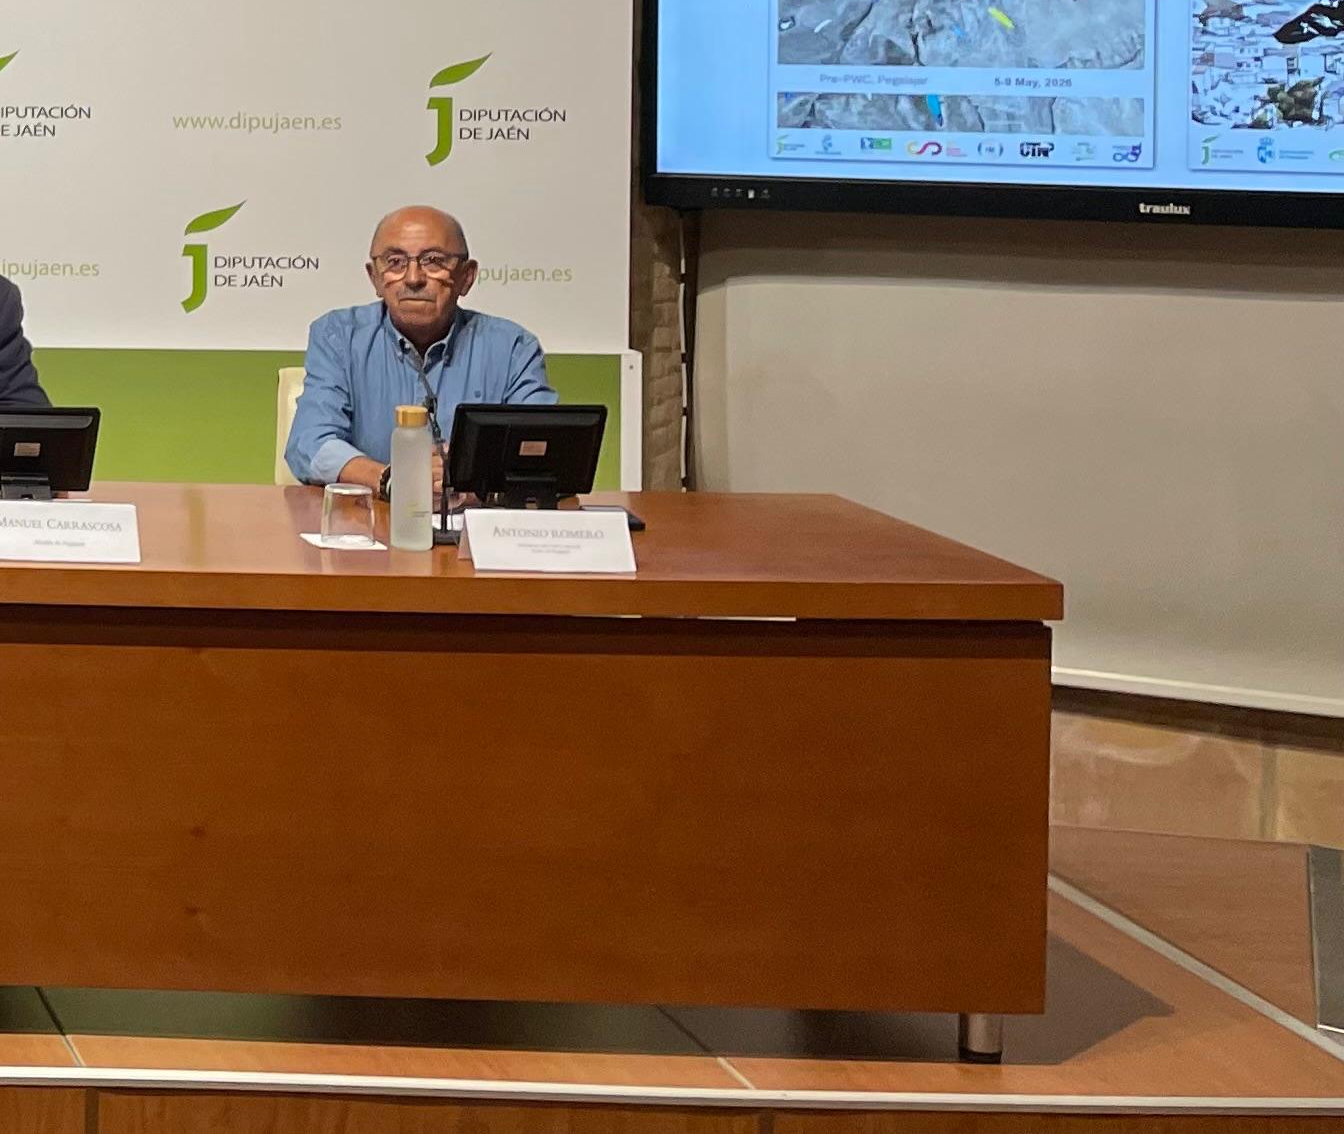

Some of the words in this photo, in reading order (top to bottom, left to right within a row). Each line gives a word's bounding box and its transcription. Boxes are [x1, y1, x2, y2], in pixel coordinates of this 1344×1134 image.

[460, 107, 566, 122] DIPUTACIÓN
[14, 122, 55, 137] JAÉN
[173, 111, 342, 134] www.dipujaen.es
[460, 128, 481, 140] DE
[487, 126, 529, 140] JAÉN
[215, 255, 319, 270] DIPUTACIÓN
[215, 275, 236, 286] DE
[241, 273, 283, 287] JAÉN
[47, 518, 122, 532] CARRASCOSA
[493, 526, 549, 538] ANTONIO
